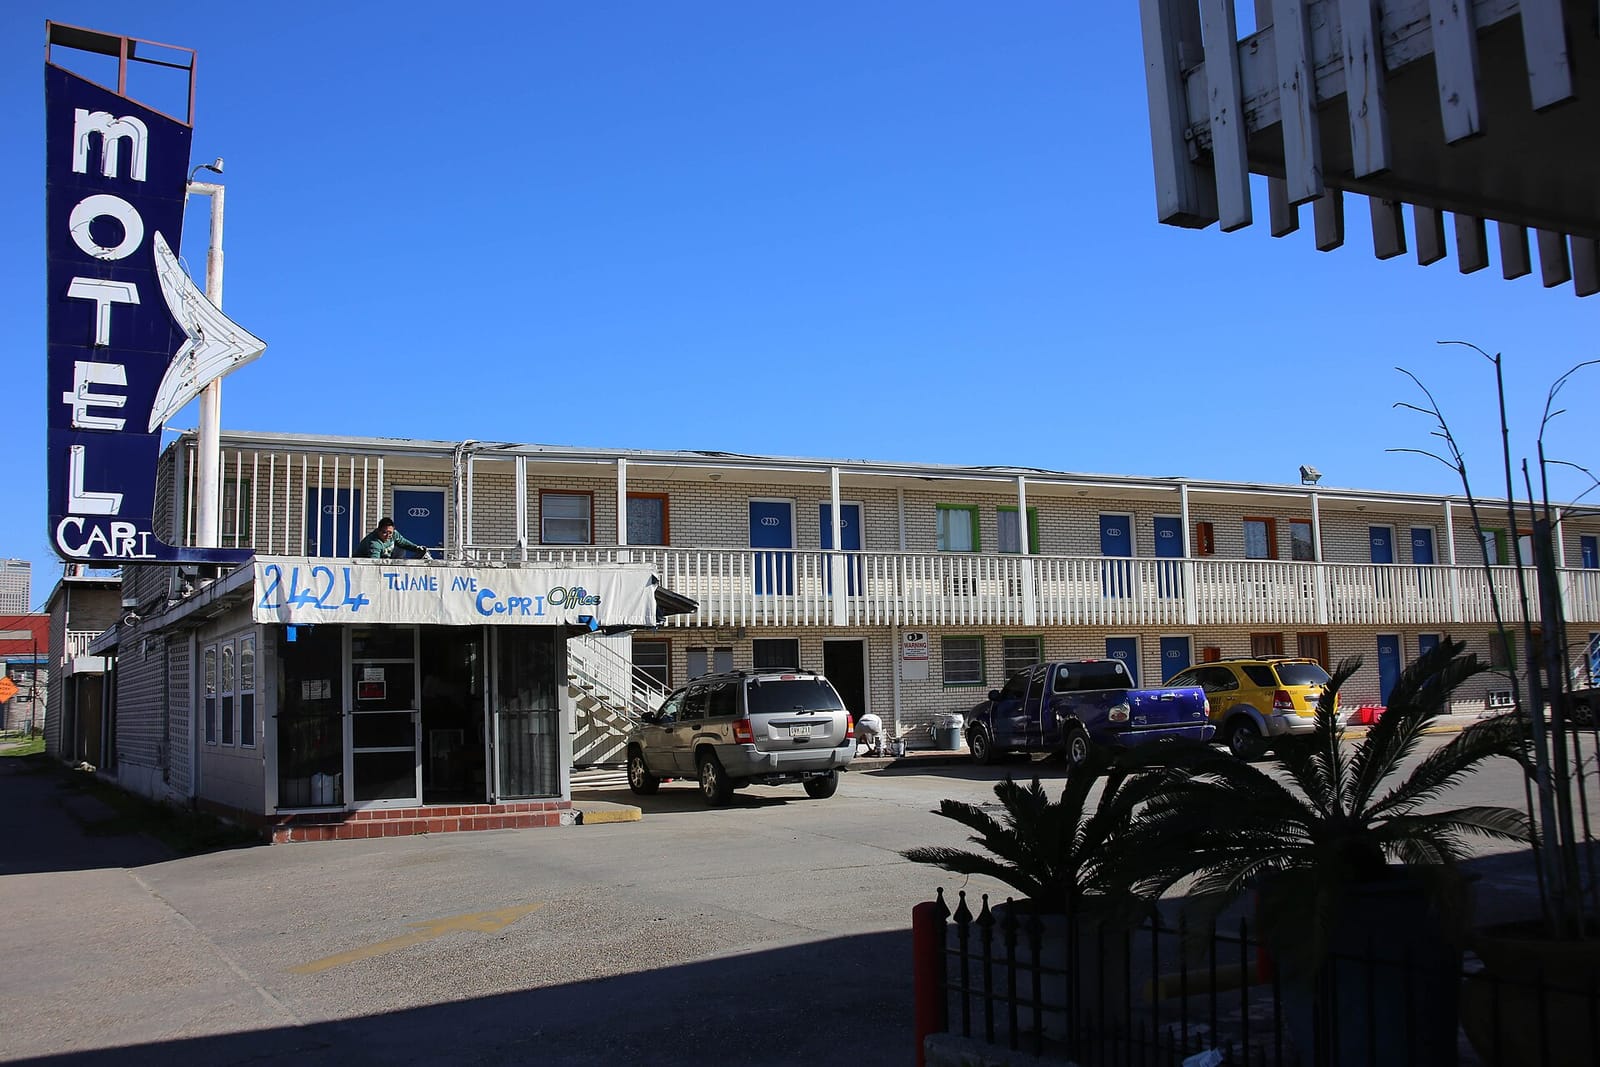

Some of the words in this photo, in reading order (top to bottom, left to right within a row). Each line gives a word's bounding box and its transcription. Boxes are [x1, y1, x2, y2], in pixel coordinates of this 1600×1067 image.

[57, 517, 156, 558] CAPRI
[259, 564, 370, 611] 2424
[451, 575, 477, 592] AVE
[547, 586, 601, 609] Office
